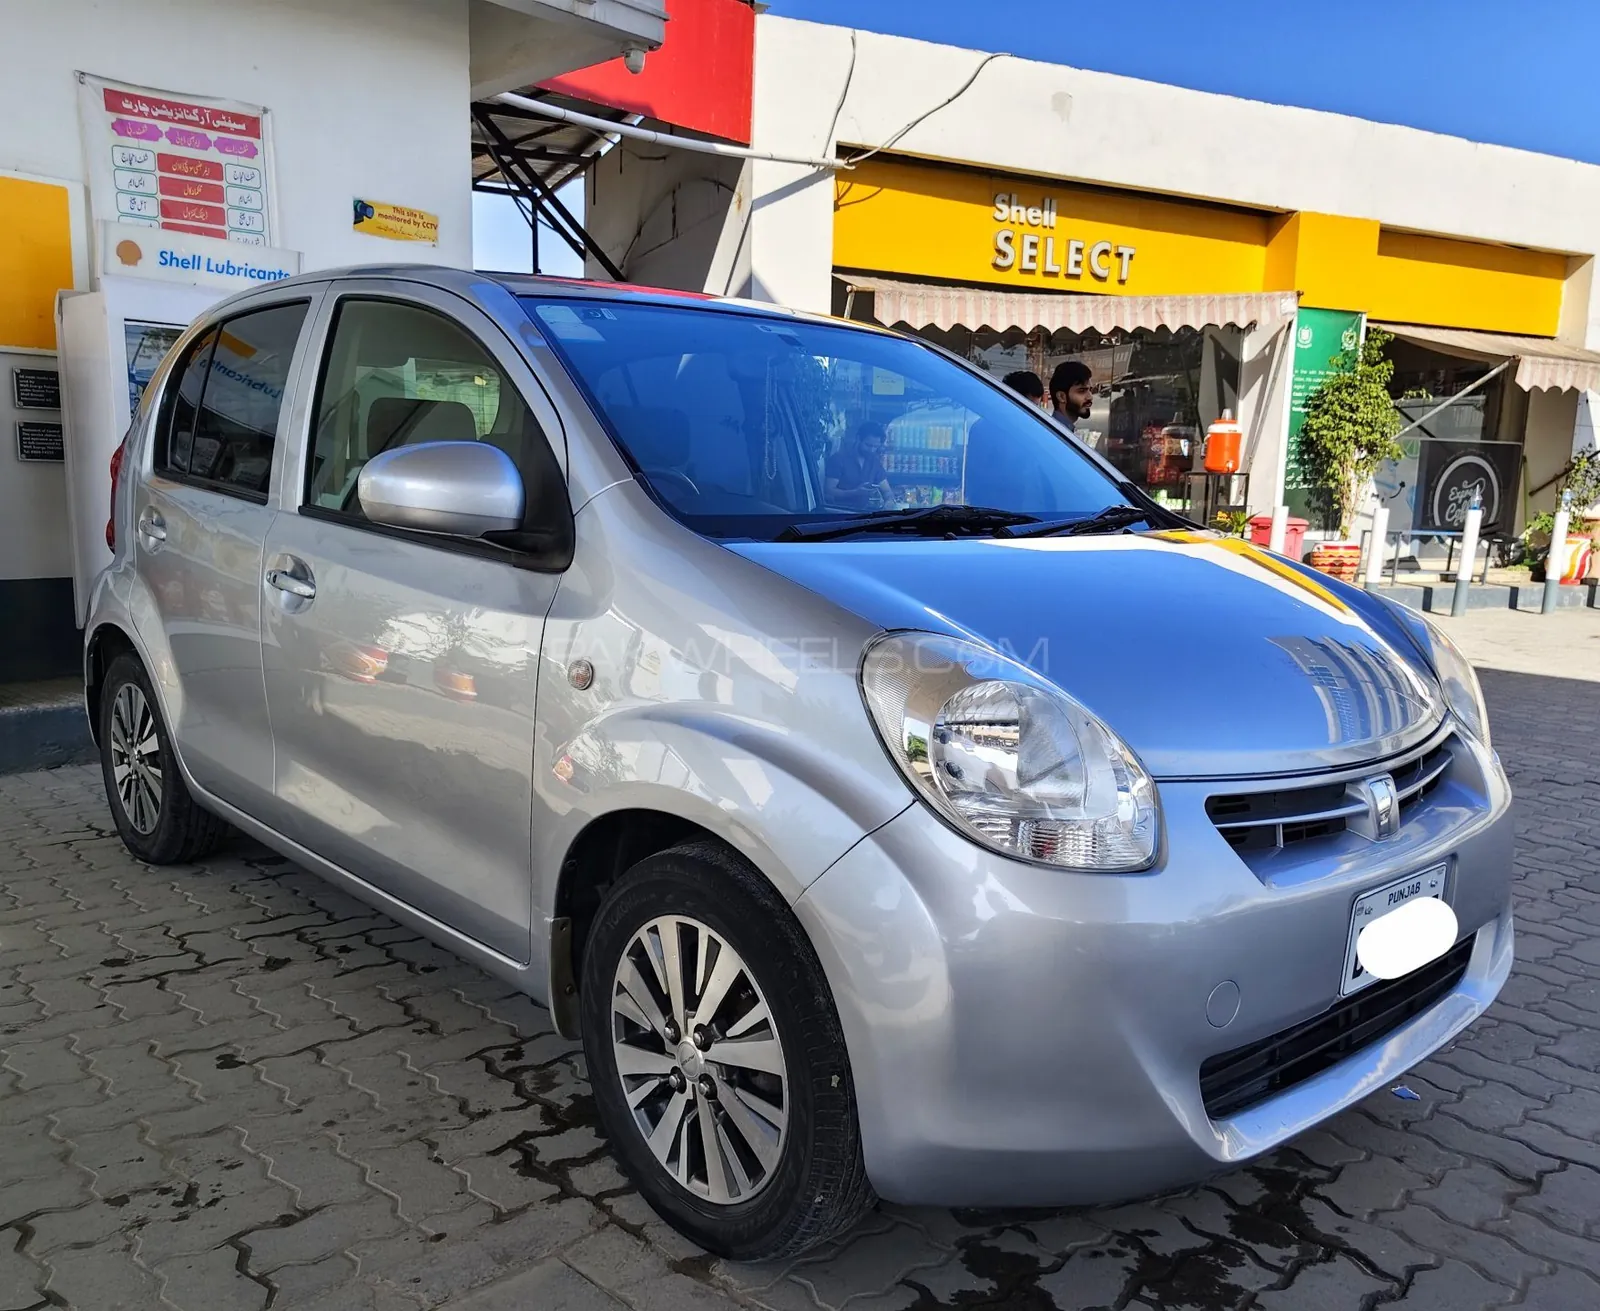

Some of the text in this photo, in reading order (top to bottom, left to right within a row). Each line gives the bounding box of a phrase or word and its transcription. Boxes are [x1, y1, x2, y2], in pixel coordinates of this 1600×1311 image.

[378, 212, 438, 230] monitored by CCTV
[392, 206, 424, 220] This site is
[993, 193, 1058, 229] Shell
[159, 250, 291, 282] Shell Lubricants
[991, 228, 1137, 285] SELECT
[1387, 882, 1421, 906] PUNJAB
